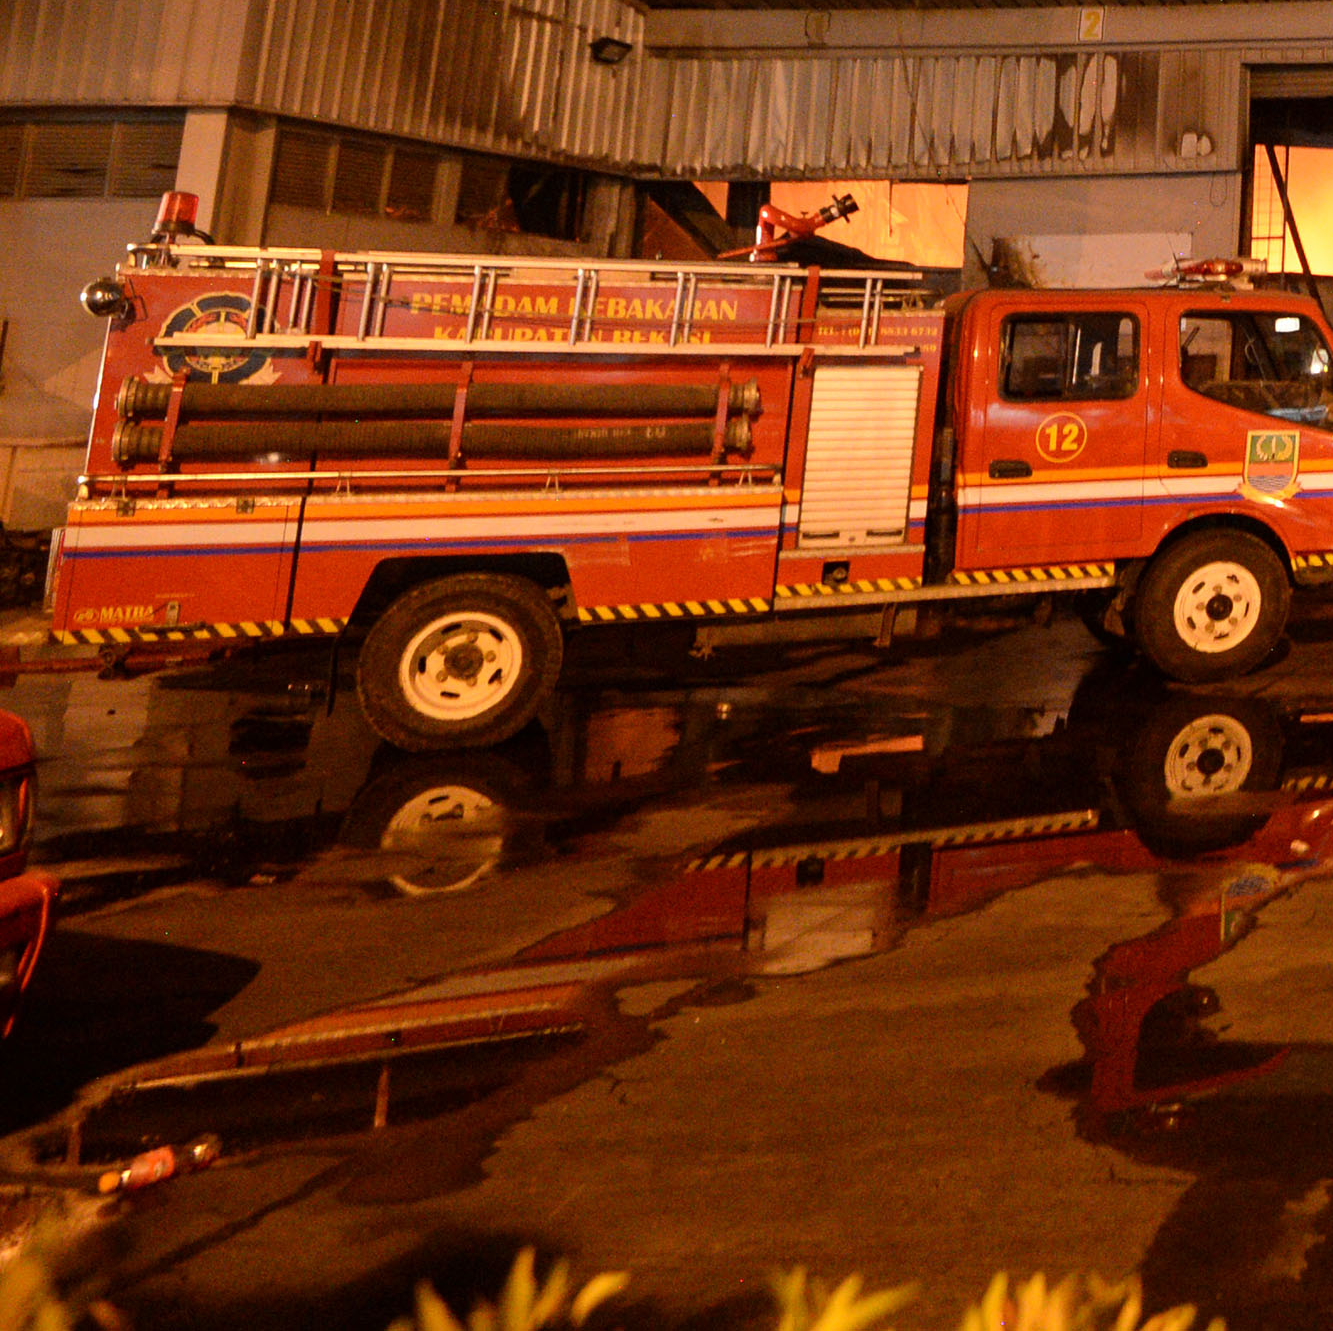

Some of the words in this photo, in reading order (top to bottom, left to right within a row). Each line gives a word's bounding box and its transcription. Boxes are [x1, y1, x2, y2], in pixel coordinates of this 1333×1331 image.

[1083, 10, 1101, 38] 2
[434, 326, 602, 342] KAUPATN
[613, 329, 711, 343] BEKSI
[1045, 422, 1080, 452] 12
